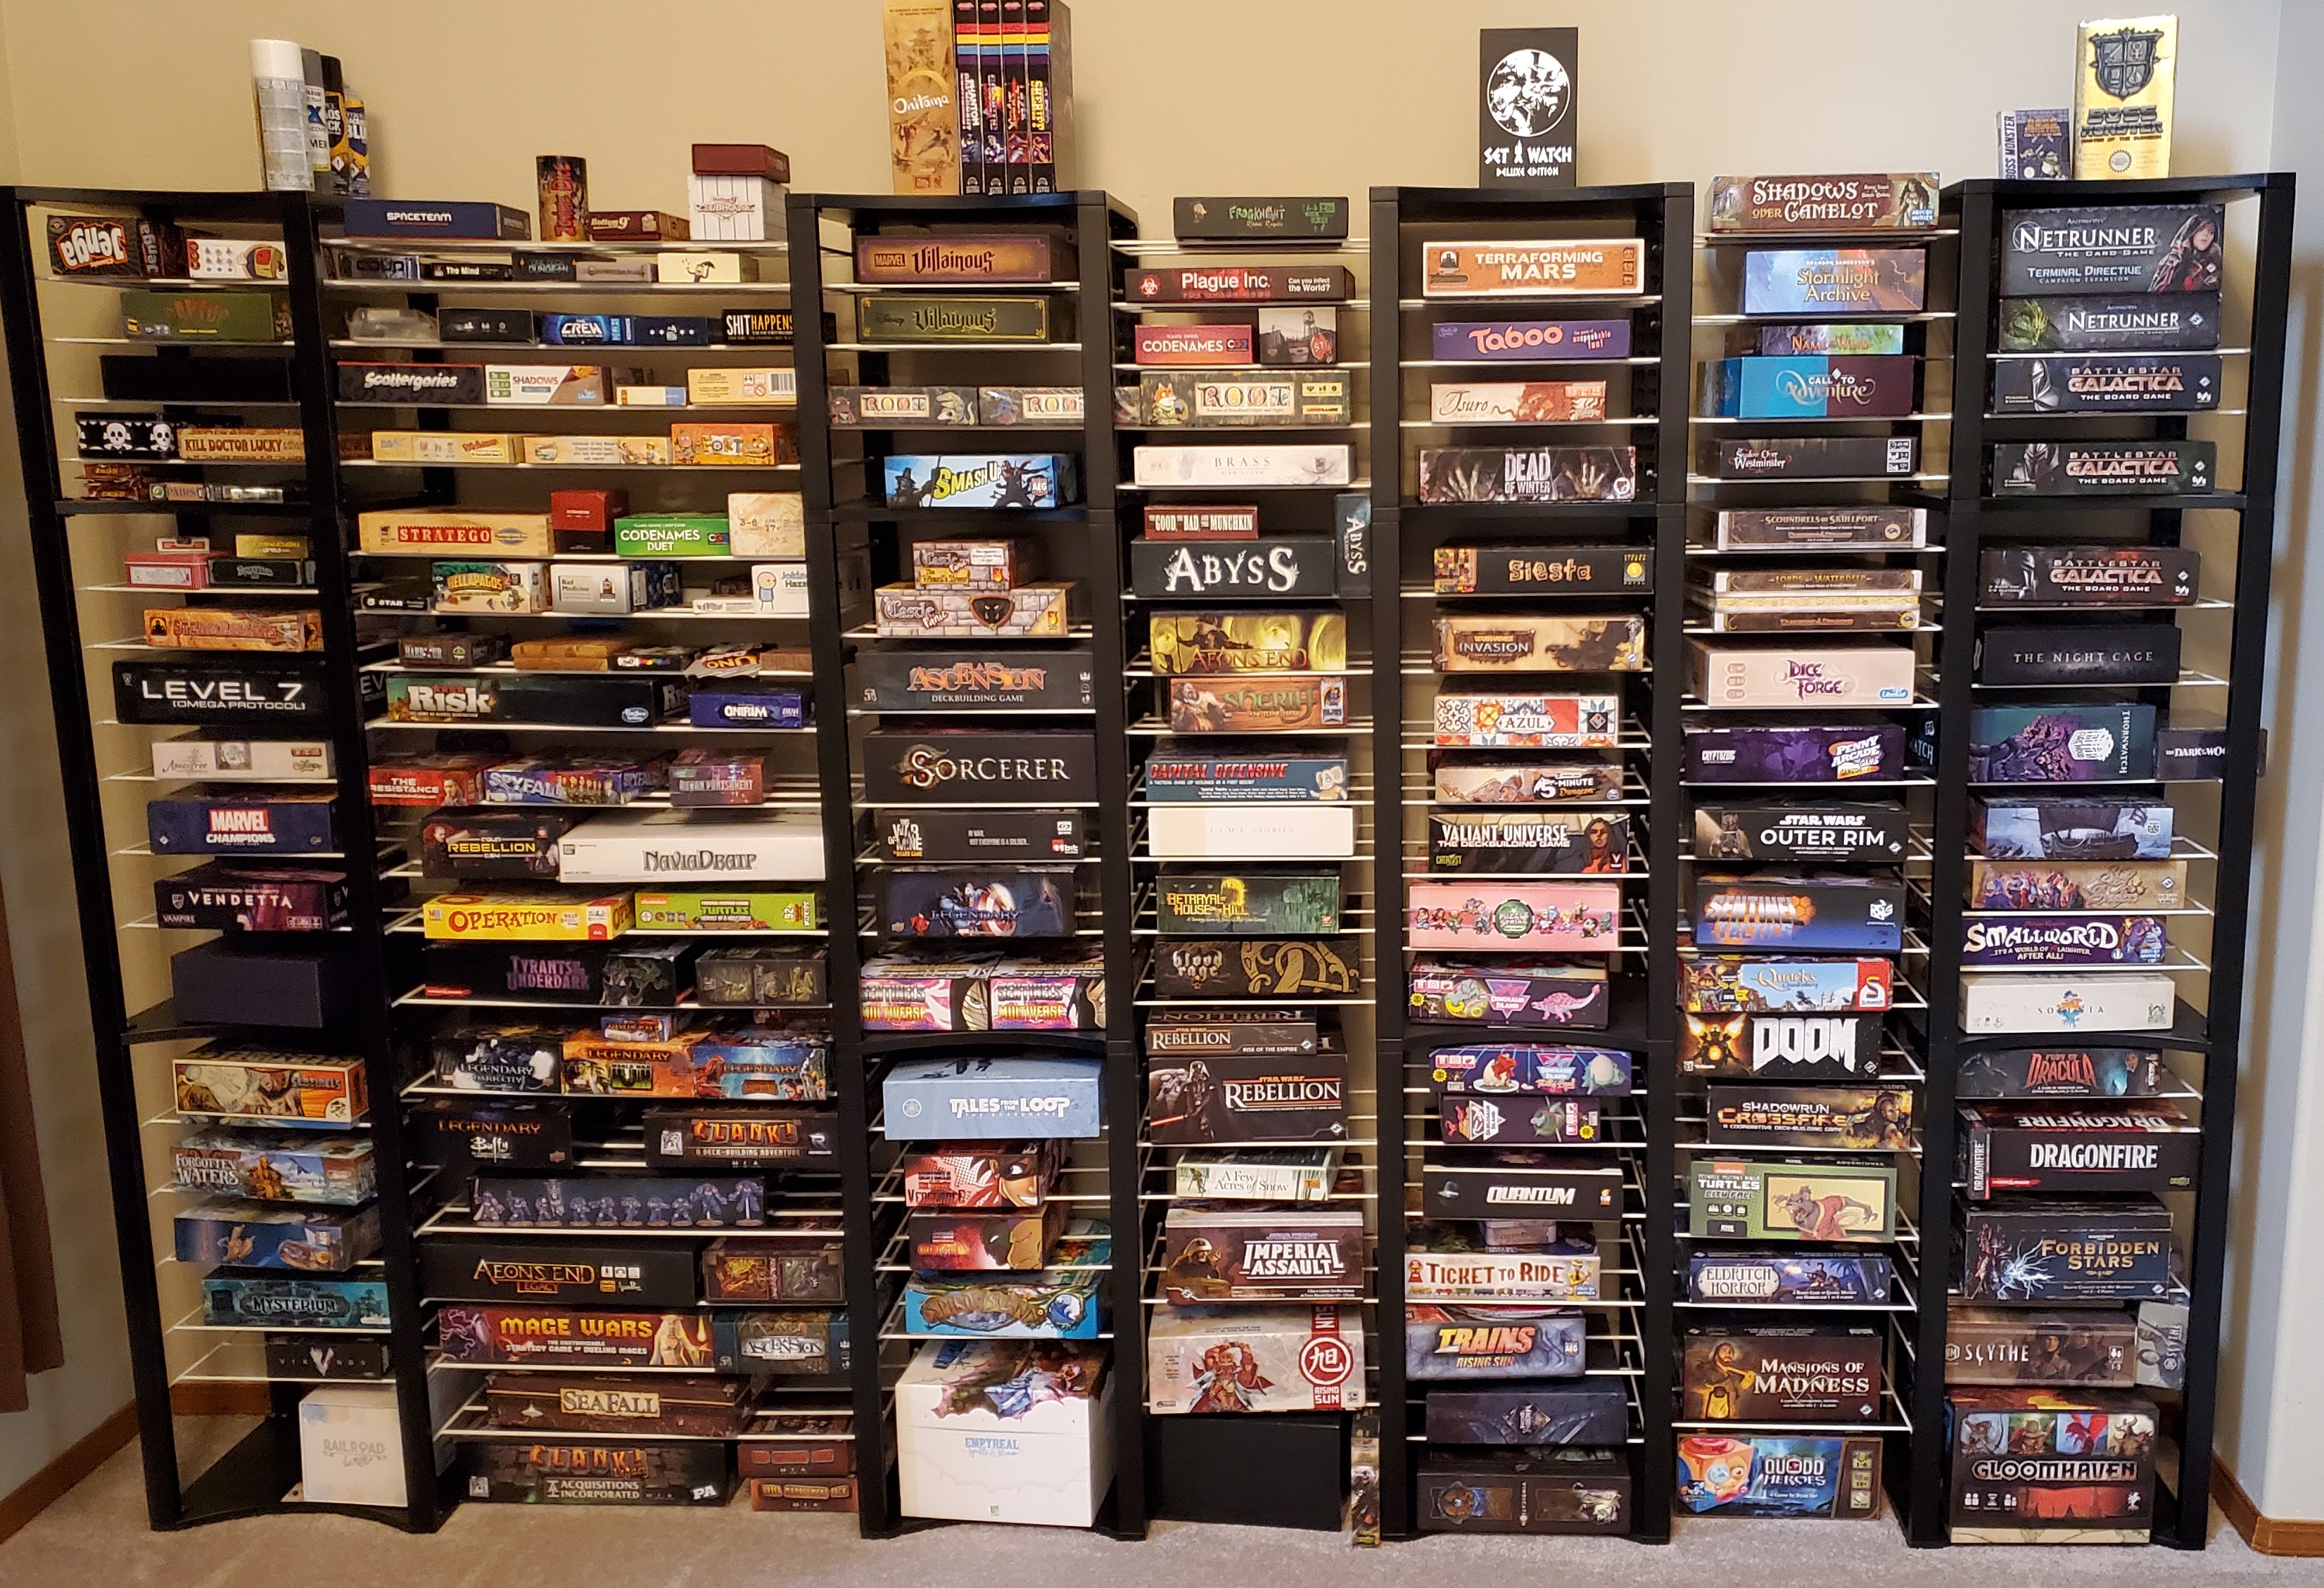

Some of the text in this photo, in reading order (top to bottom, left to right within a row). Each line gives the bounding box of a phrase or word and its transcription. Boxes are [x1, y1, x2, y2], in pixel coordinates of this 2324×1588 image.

[894, 94, 949, 113] Onitama
[1496, 167, 1558, 177] DELUXE EDITION
[1753, 179, 1860, 205] SHADOWS
[387, 212, 452, 222] SPACETEAM
[1752, 203, 1878, 222] OVER CAMELOT
[2020, 227, 2155, 250] NETRUNNER
[875, 254, 905, 266] MARVEL
[912, 246, 995, 274] Villainous
[1475, 252, 1603, 265] TERRAFORMING
[446, 267, 479, 275] The Mind
[1501, 263, 1577, 280] MARS
[1798, 267, 1879, 288] Stormlight
[2027, 266, 2142, 278] TERMINAL DIRECTIVE
[1181, 273, 1271, 291] Plague Inc.
[1303, 284, 1331, 292] World?
[1804, 284, 1870, 302] Archive
[913, 305, 997, 332] Villainous
[2069, 312, 2180, 331] NETRUNNER
[1142, 341, 1224, 352] CODENAMES
[1468, 326, 1563, 354] Taboo
[2071, 366, 2182, 375] BATTLESTAR
[364, 371, 457, 391] Scattergories
[513, 376, 558, 386] SHADOWS
[1808, 376, 1855, 385] CALL TO
[2068, 377, 2183, 393] GALACTICA
[862, 396, 927, 411] ROOT
[1198, 386, 1291, 407] ROOT
[185, 440, 281, 452] KILL DOCTOR LUCKY
[1215, 457, 1271, 467] BRASS
[1505, 453, 1549, 476] DEAD
[1734, 457, 1786, 470] Westminster
[2066, 461, 2180, 476] GALACTICA
[934, 462, 1003, 500] SMASH UP
[1505, 481, 1550, 494] OF WINTER
[399, 528, 490, 542] STRATEGO
[620, 529, 700, 541] CODENAMES
[647, 542, 673, 551] DUET
[1164, 546, 1300, 592] ABYSS
[1509, 558, 1592, 582] Siesta
[2050, 568, 2163, 584] GALACTICA
[1459, 642, 1528, 654] INVASION
[2014, 651, 2154, 663] THE NIGHT CAGE
[906, 662, 1047, 692] ASCENSION
[142, 680, 302, 701] LEVEL 7
[1504, 717, 1545, 729] AZUL
[911, 751, 1071, 787] SORCERER
[1149, 763, 1289, 779] CAPITAL OFFENSIVE
[390, 777, 417, 786] THE
[211, 811, 267, 832] MARVEL
[1779, 815, 1866, 825] STAR WARS
[206, 834, 276, 843] CHAMPIONS
[1442, 825, 1568, 842] VALIANT UNIVERSE
[1760, 829, 1886, 846] OUTER RIM
[448, 843, 535, 852] REBELLION
[187, 891, 293, 909] VENDETTA
[1166, 892, 1221, 906] BETRAYAL
[449, 911, 558, 932] OPERATION
[931, 910, 1020, 921] LEGENDARY
[1152, 1032, 1231, 1050] REBELLION
[1751, 1018, 1860, 1072] DOOM
[587, 1050, 670, 1061] LEGENDARY
[460, 1063, 533, 1075] LEGENDARY
[724, 1064, 798, 1074] LEGENDARY
[1223, 1082, 1341, 1108] REBELLION
[950, 1098, 1000, 1119] TALES
[1021, 1098, 1070, 1119] LOOP
[1742, 1103, 1829, 1114] SHADOWRUN
[1717, 1108, 1848, 1126] CROSSFIRE
[438, 1120, 541, 1135] LEGENDARY
[176, 1153, 236, 1169] FORGOTTEN
[2030, 1144, 2159, 1169] DRAGONFIRE
[1974, 1141, 1984, 1191] DRAGONFIRE
[179, 1168, 239, 1186] WATERS
[1221, 1171, 1256, 1181] A Few
[1215, 1182, 1244, 1190] Acres
[1259, 1181, 1289, 1192] Snow
[1698, 1179, 1760, 1190] TURTLES
[1487, 1186, 1575, 1205] QUANTUM
[1243, 1244, 1343, 1269] IMPERIAL
[2042, 1240, 2159, 1257] FORBIDDEN
[1251, 1259, 1333, 1275] ASSAULT
[2067, 1257, 2133, 1270] STARS
[1426, 1262, 1564, 1285] TICKET TO RIDE
[1706, 1268, 1771, 1281] ELDRITCH
[1711, 1281, 1767, 1296] HORROR
[252, 1297, 338, 1313] MYSTERIUM
[500, 1317, 652, 1338] MAGE WARS
[744, 1338, 823, 1354] ASCENSION
[1435, 1326, 1537, 1354] TRAINS
[1309, 1347, 1344, 1373] 旭
[1761, 1359, 1865, 1373] MANSIONS OF
[1753, 1376, 1870, 1395] MADNESS
[1315, 1395, 1339, 1404] SUN
[324, 1438, 385, 1455] RAILROAD
[965, 1437, 1019, 1449] EMPYREAL
[1971, 1460, 2138, 1482] GLOOMHAVEN
[561, 1480, 639, 1489] ACQUISITIONS
[561, 1490, 640, 1499] INCORPORATED
